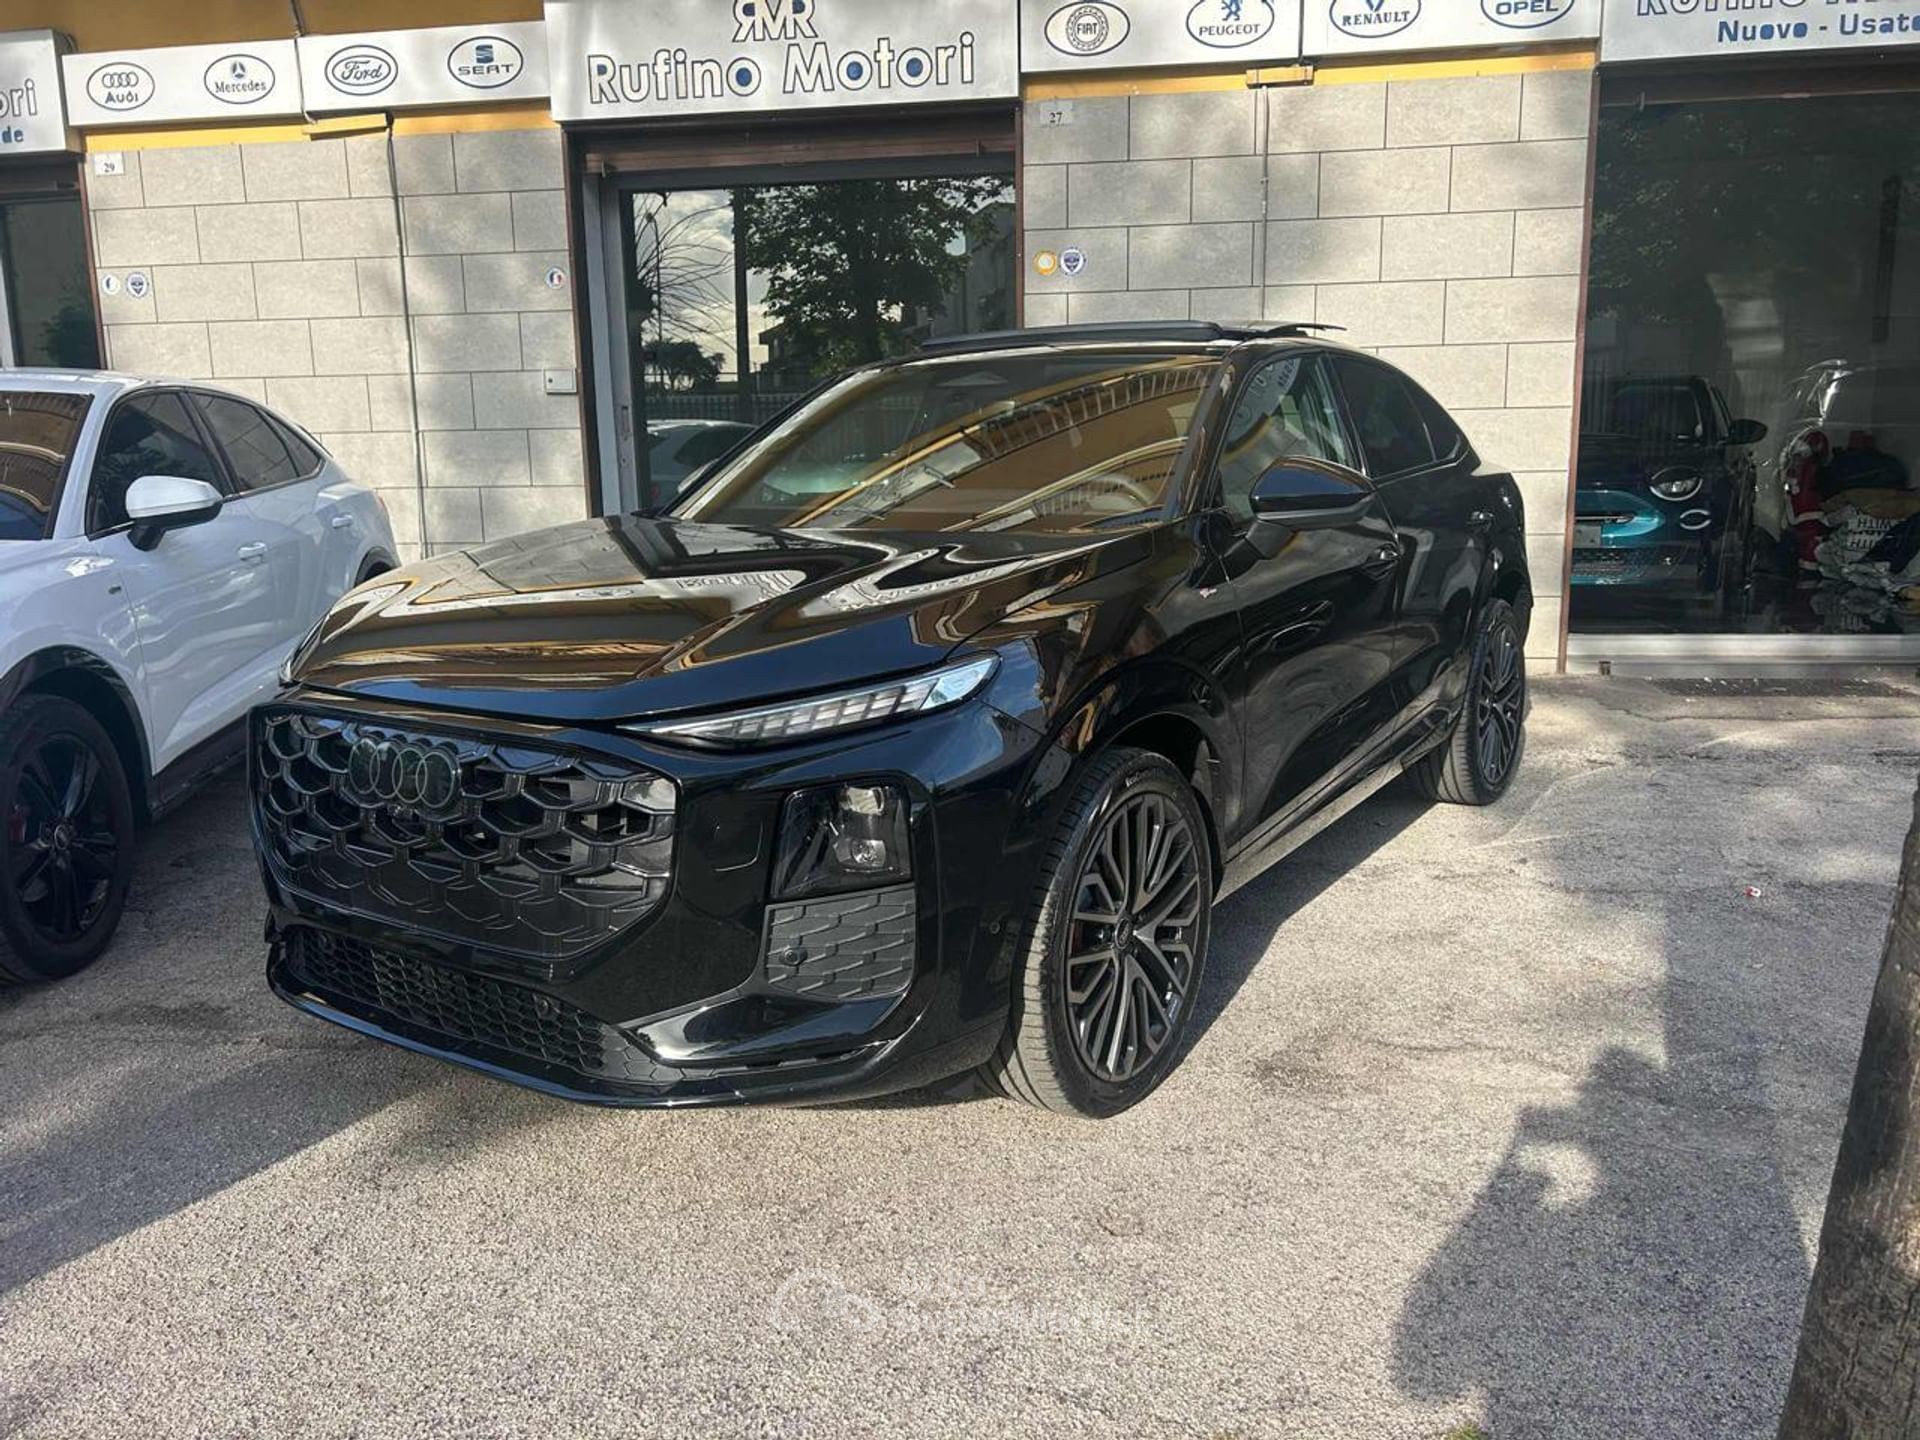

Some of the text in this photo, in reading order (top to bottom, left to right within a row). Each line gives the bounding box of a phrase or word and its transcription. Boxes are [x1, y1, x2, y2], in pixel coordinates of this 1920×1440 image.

[1495, 0, 1559, 15] OPEL
[1342, 11, 1410, 26] RENAULT
[1076, 22, 1098, 35] FIAT
[1199, 23, 1261, 36] PEUGEOT
[1717, 19, 1808, 43] Nuovo
[341, 59, 383, 81] Ford
[458, 64, 514, 76] SEAT
[587, 31, 975, 104] Rufino Motori
[214, 80, 267, 94] Mercedes
[104, 91, 139, 104] Audi
[1049, 111, 1063, 125] 27
[104, 161, 115, 173] 29
